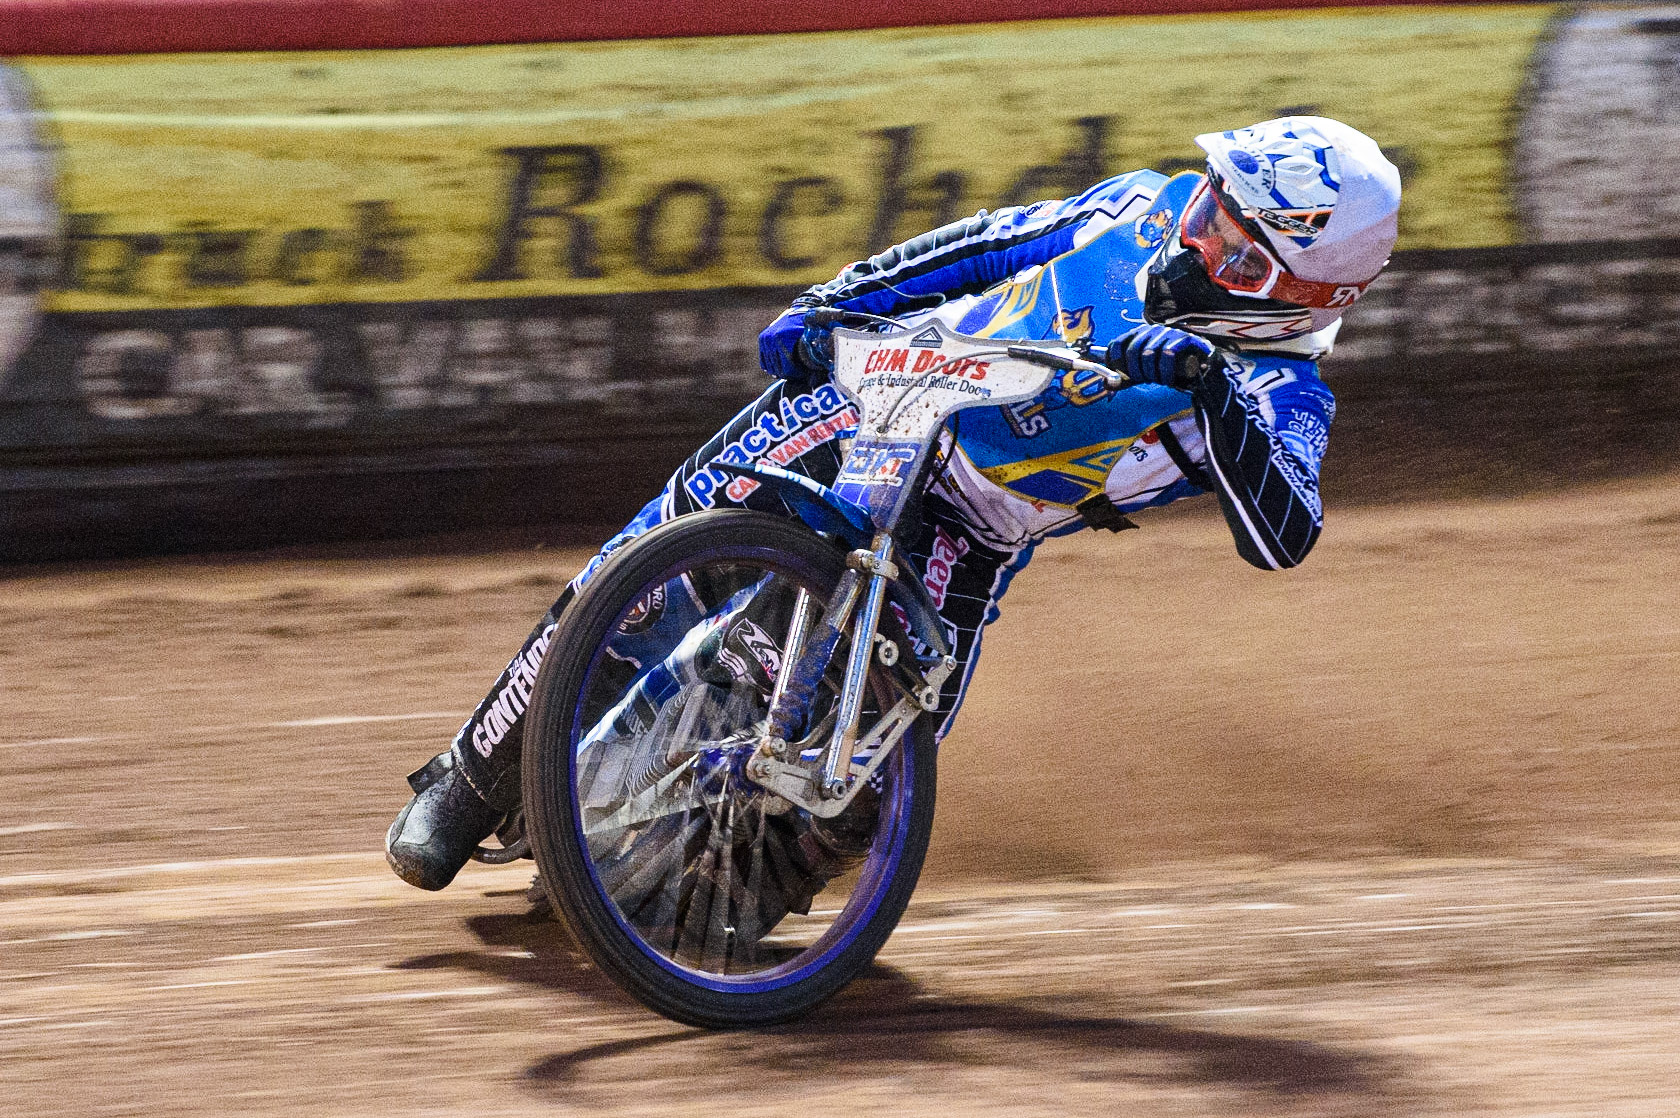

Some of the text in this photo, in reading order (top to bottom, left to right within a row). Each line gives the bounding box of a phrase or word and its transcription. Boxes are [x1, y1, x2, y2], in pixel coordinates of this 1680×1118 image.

[458, 106, 1300, 287] Rochd
[864, 348, 909, 375] CHM
[886, 373, 927, 388] Industal
[685, 384, 850, 509] practica
[767, 433, 810, 466] VAN
[805, 405, 862, 445] RENTAL
